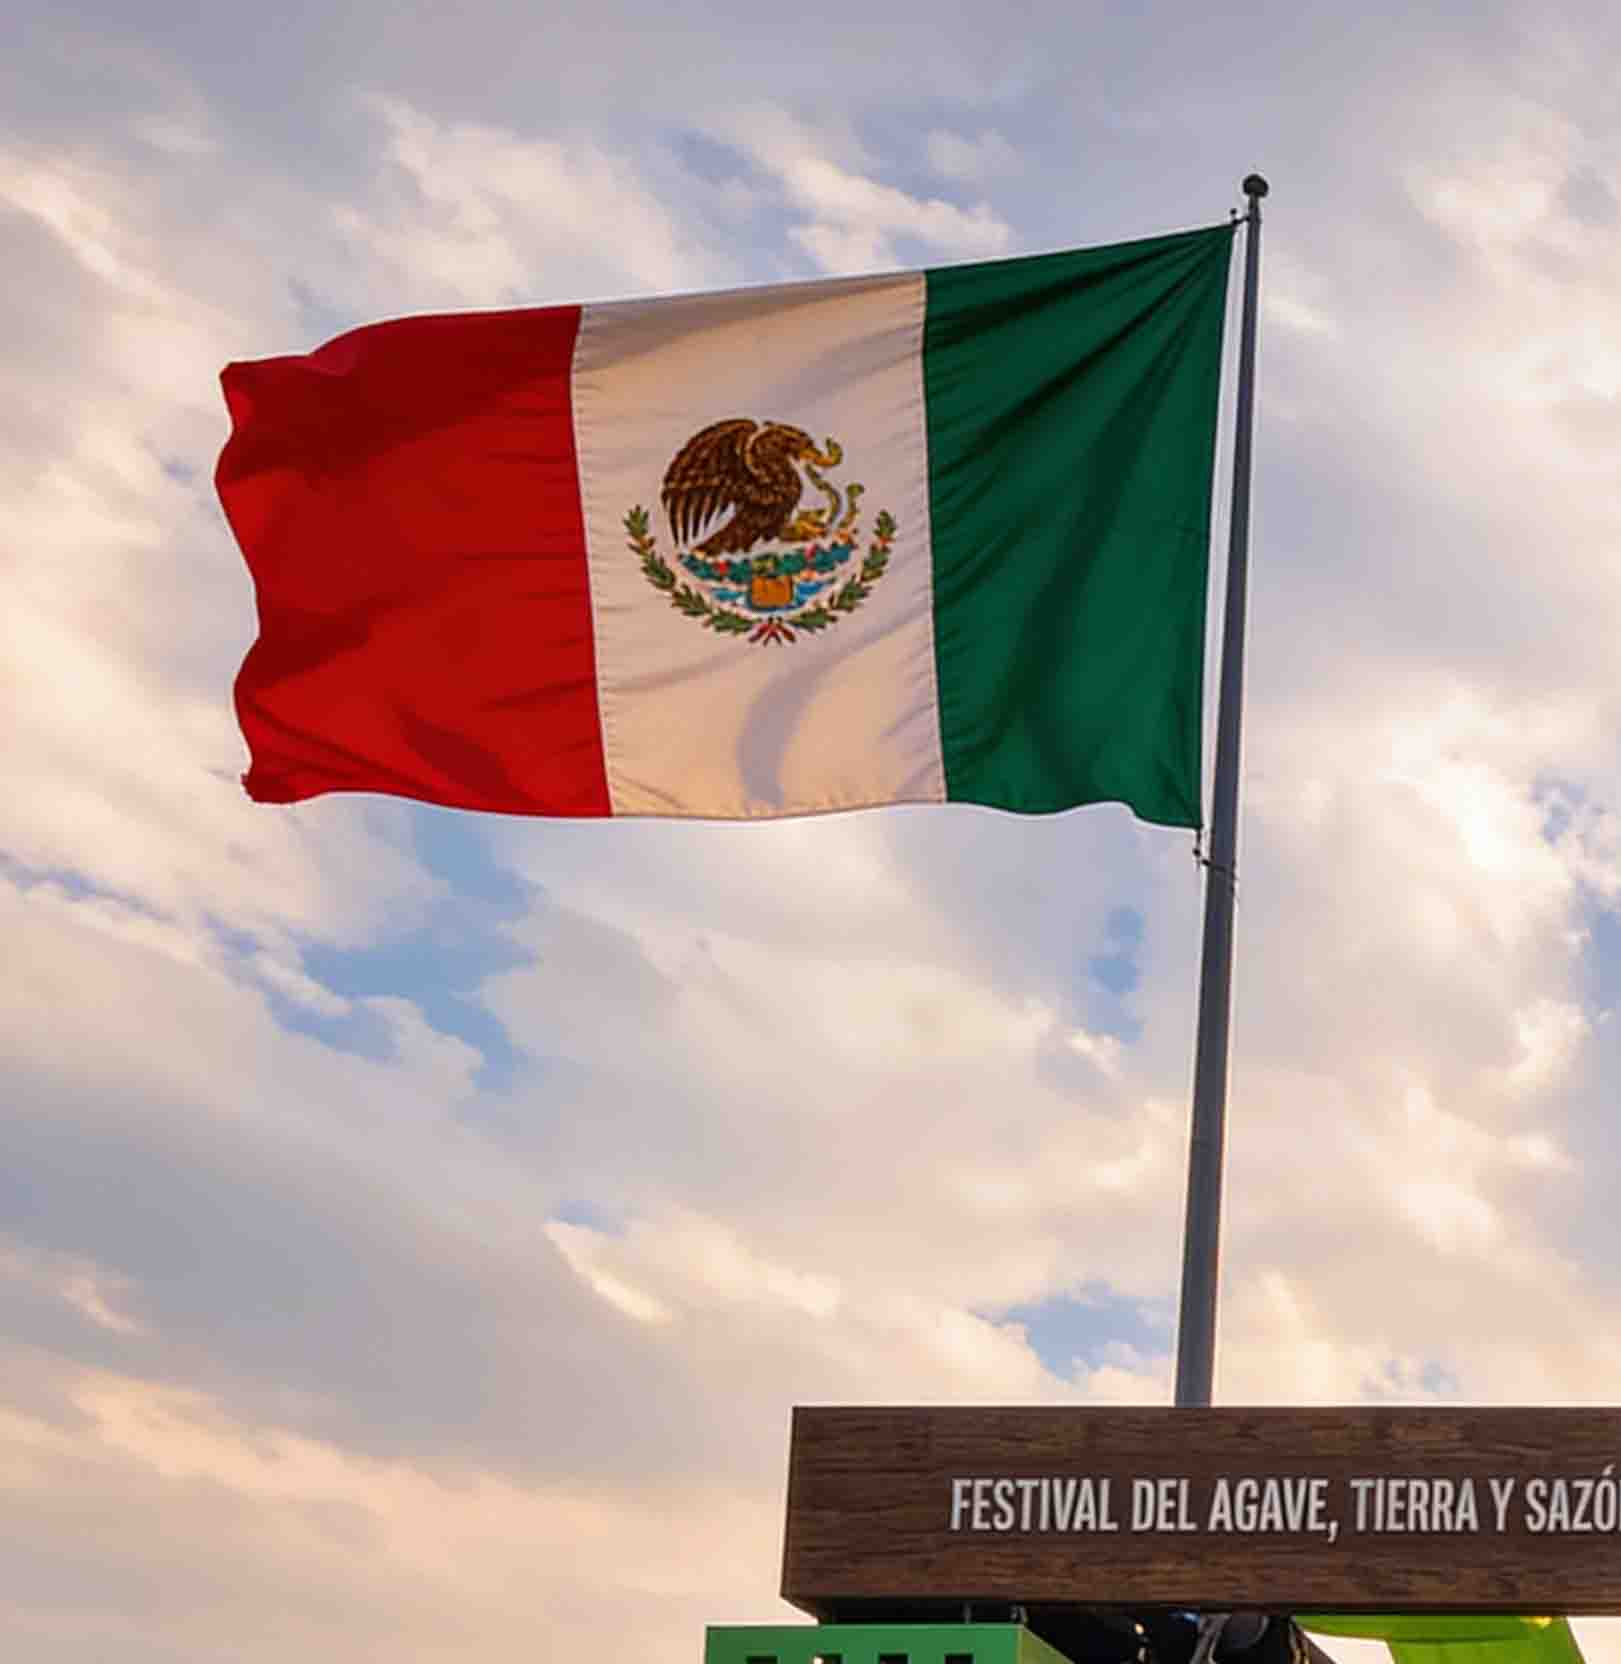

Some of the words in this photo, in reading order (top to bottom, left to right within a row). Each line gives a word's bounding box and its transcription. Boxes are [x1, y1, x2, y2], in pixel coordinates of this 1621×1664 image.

[950, 1478, 1120, 1532] FESTIVAL
[1130, 1478, 1198, 1532] DEL
[1206, 1477, 1339, 1543] AGAVE,
[1349, 1477, 1480, 1533] TIERRA
[1489, 1477, 1515, 1533] Y
